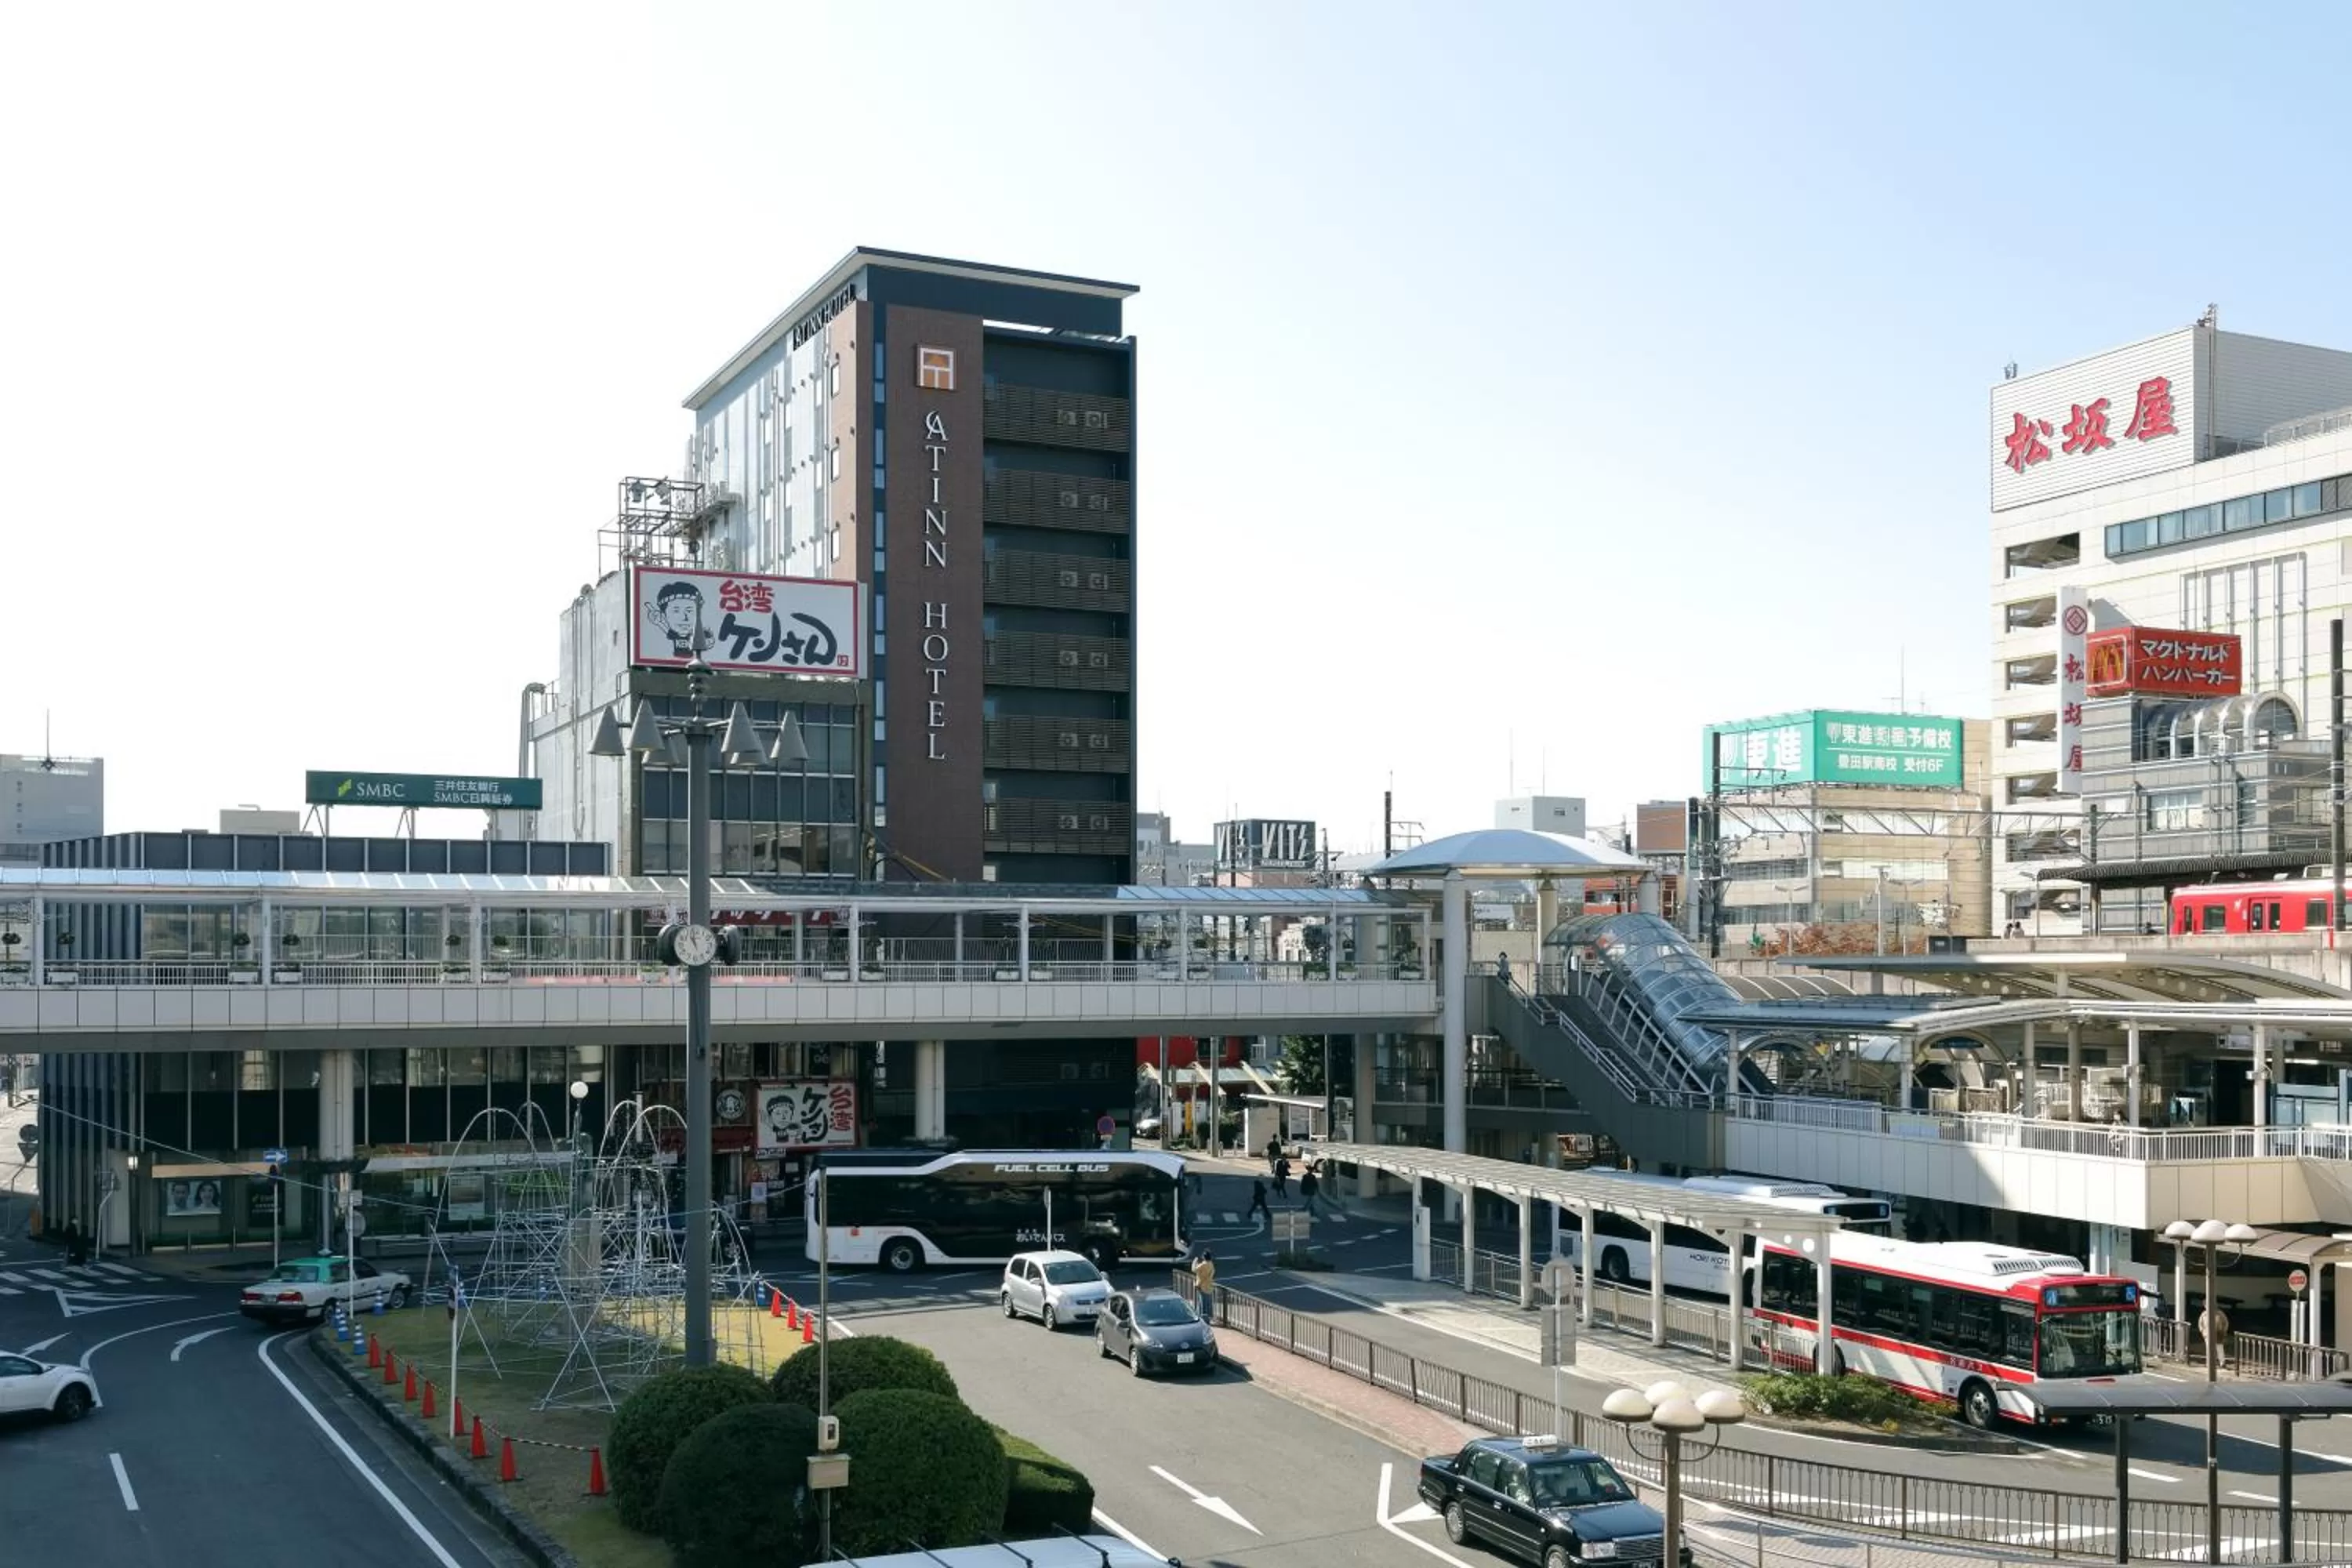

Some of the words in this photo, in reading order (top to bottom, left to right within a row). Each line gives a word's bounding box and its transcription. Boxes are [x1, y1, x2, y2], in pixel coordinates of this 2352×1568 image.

[2005, 376, 2180, 474] 松坂屋
[719, 579, 775, 614] 台湾
[718, 612, 838, 666] ケンさん
[923, 601, 949, 760] HOTEL
[356, 782, 405, 798] SMBC
[434, 780, 500, 793] 三井住友銀行
[434, 793, 514, 805] SMBC日興証券
[1261, 823, 1307, 860] VITS
[829, 1085, 853, 1131] 台湾
